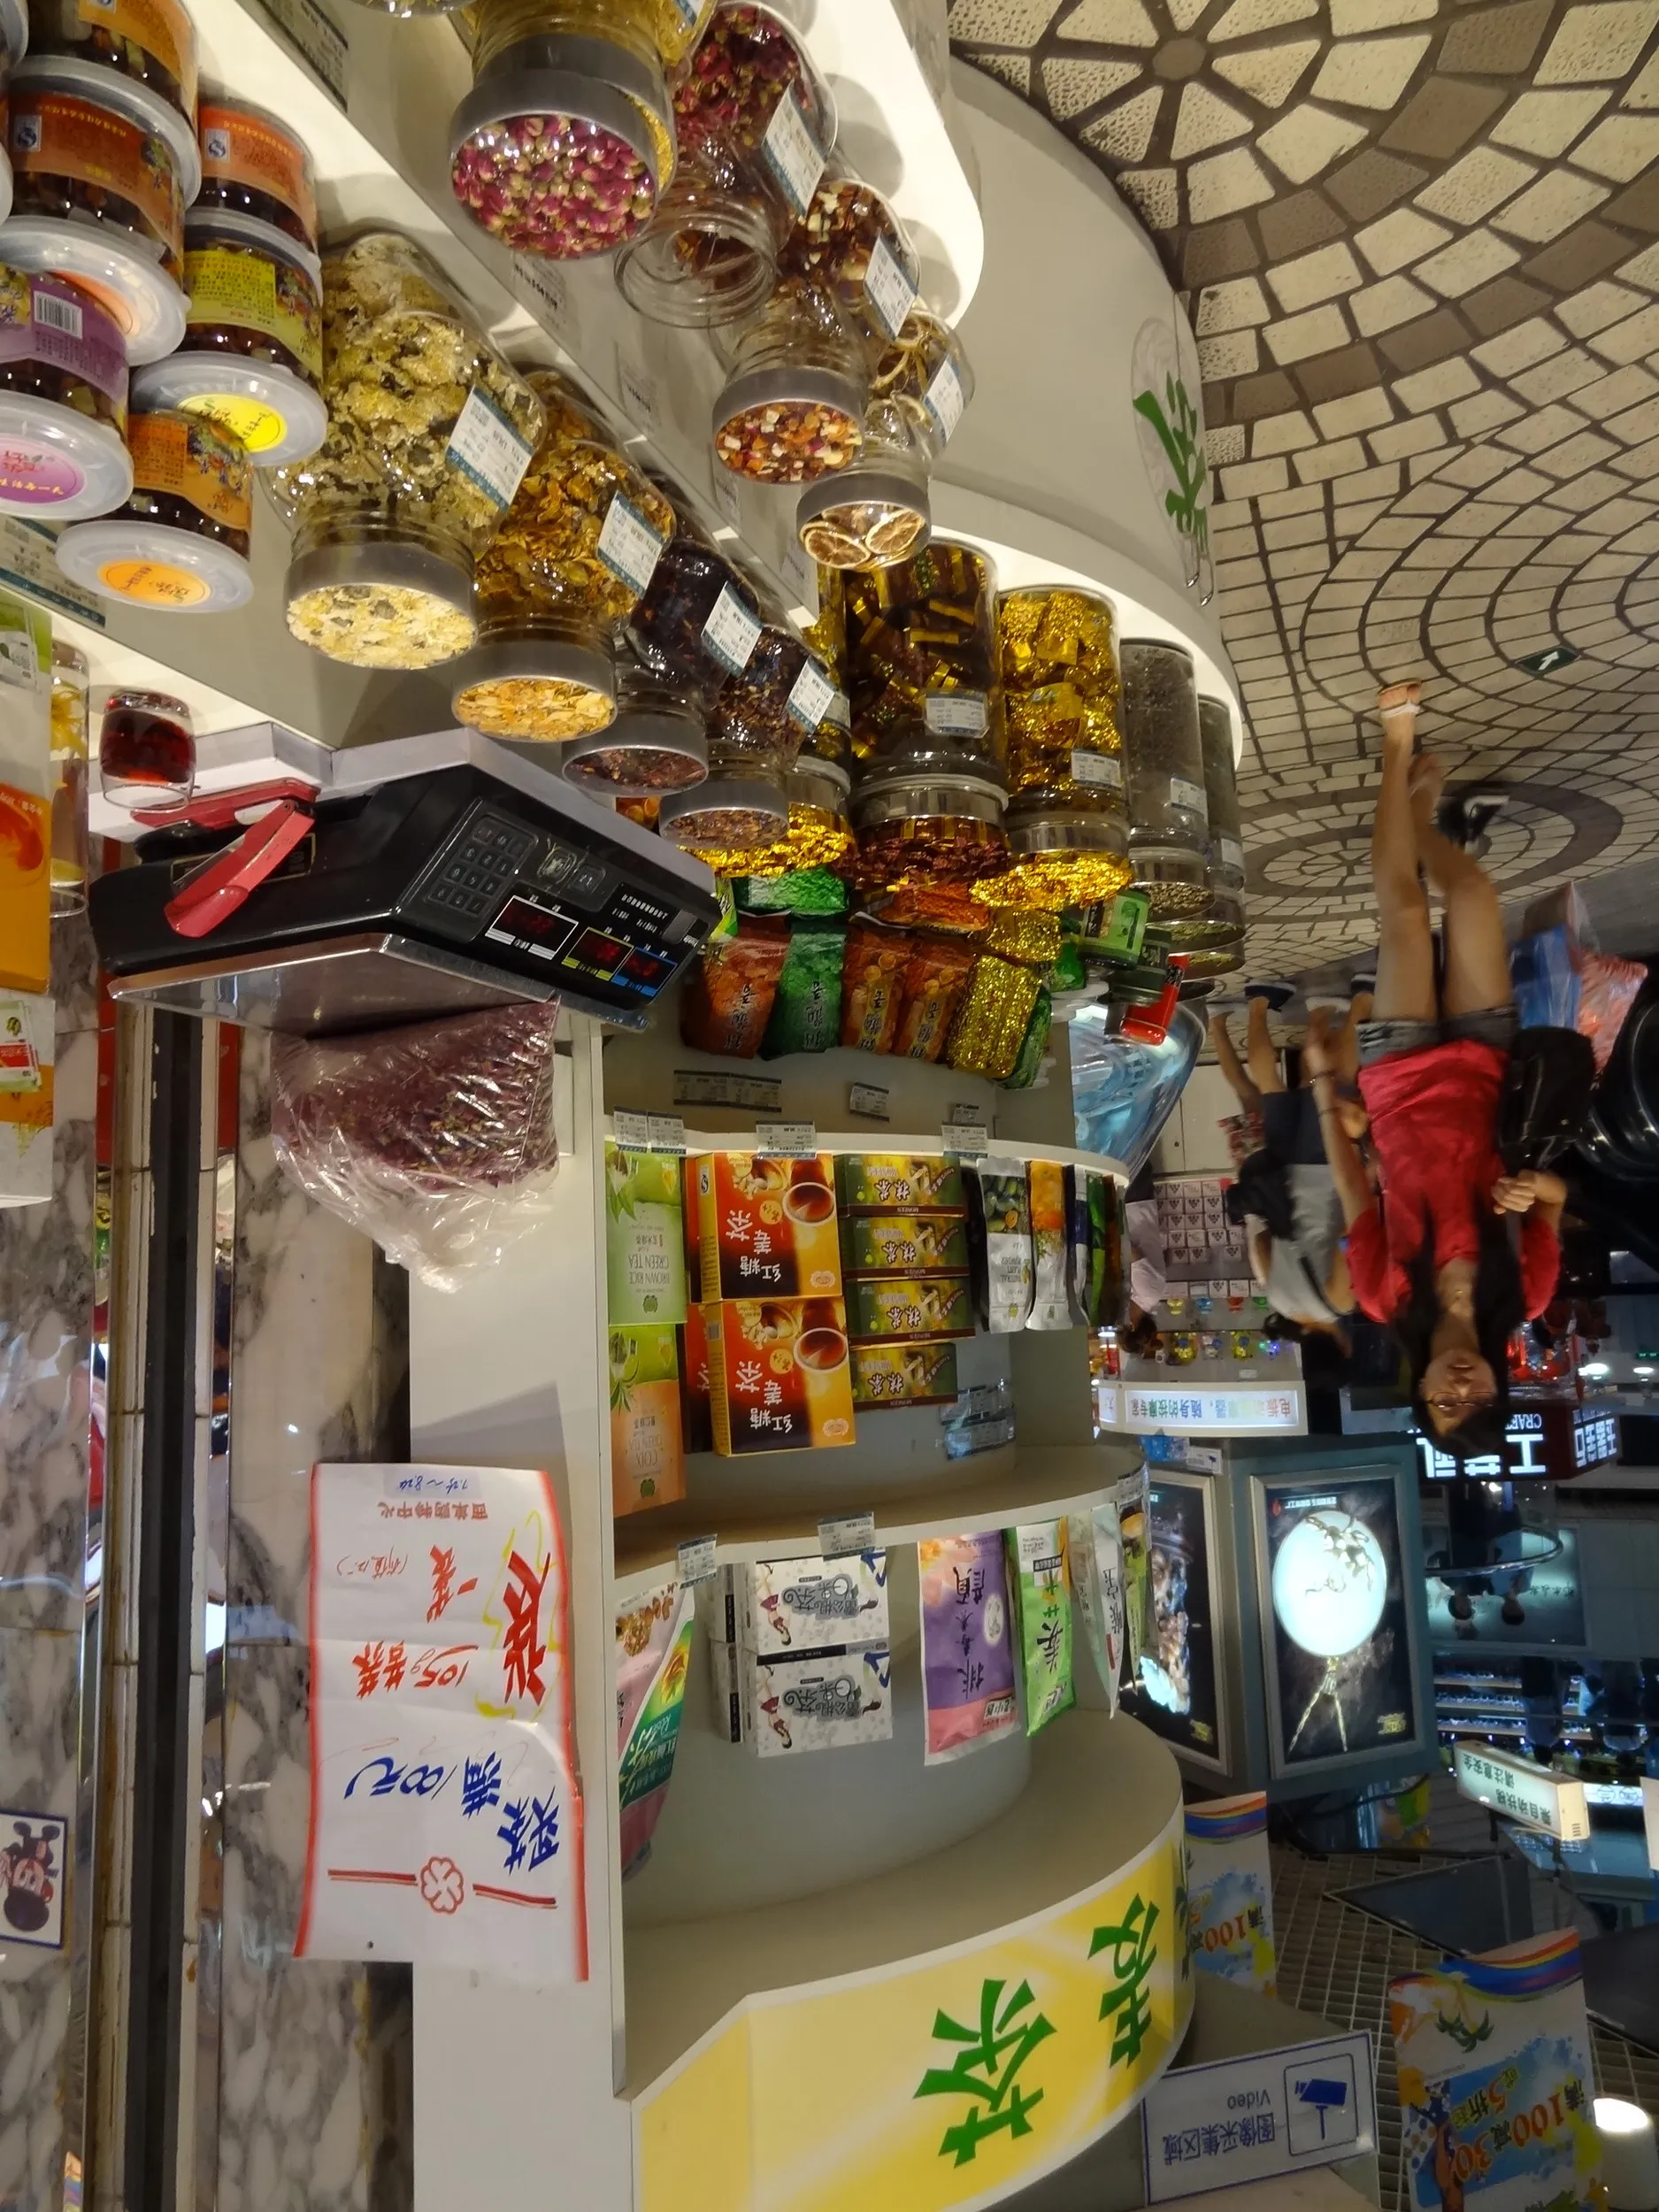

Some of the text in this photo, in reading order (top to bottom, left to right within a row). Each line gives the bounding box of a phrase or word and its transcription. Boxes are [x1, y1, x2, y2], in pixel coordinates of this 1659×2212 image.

[874, 1178, 910, 1202] 抹茶
[725, 1210, 772, 1254] 姜茶
[628, 1255, 669, 1269] GREEN TEA
[881, 1240, 917, 1265] 抹茶
[629, 1271, 670, 1285] BROWN RICE
[740, 1256, 781, 1283] 红糖
[887, 1306, 921, 1330] 抹茶
[734, 1361, 783, 1406] 姜茶
[868, 1373, 903, 1397] 抹茶
[749, 1408, 792, 1433] 红糖
[377, 1502, 488, 1520] 西单购物中心
[503, 1550, 550, 1707] 送
[1463, 1754, 1514, 1789] 请注意安全
[1495, 1788, 1552, 1826] 乘自动扶梯
[496, 1786, 559, 1877] 买茶
[912, 1842, 1190, 2169] 麦茶
[1227, 2089, 1271, 2110] Video
[1163, 2113, 1275, 2166] 图像采集区域
